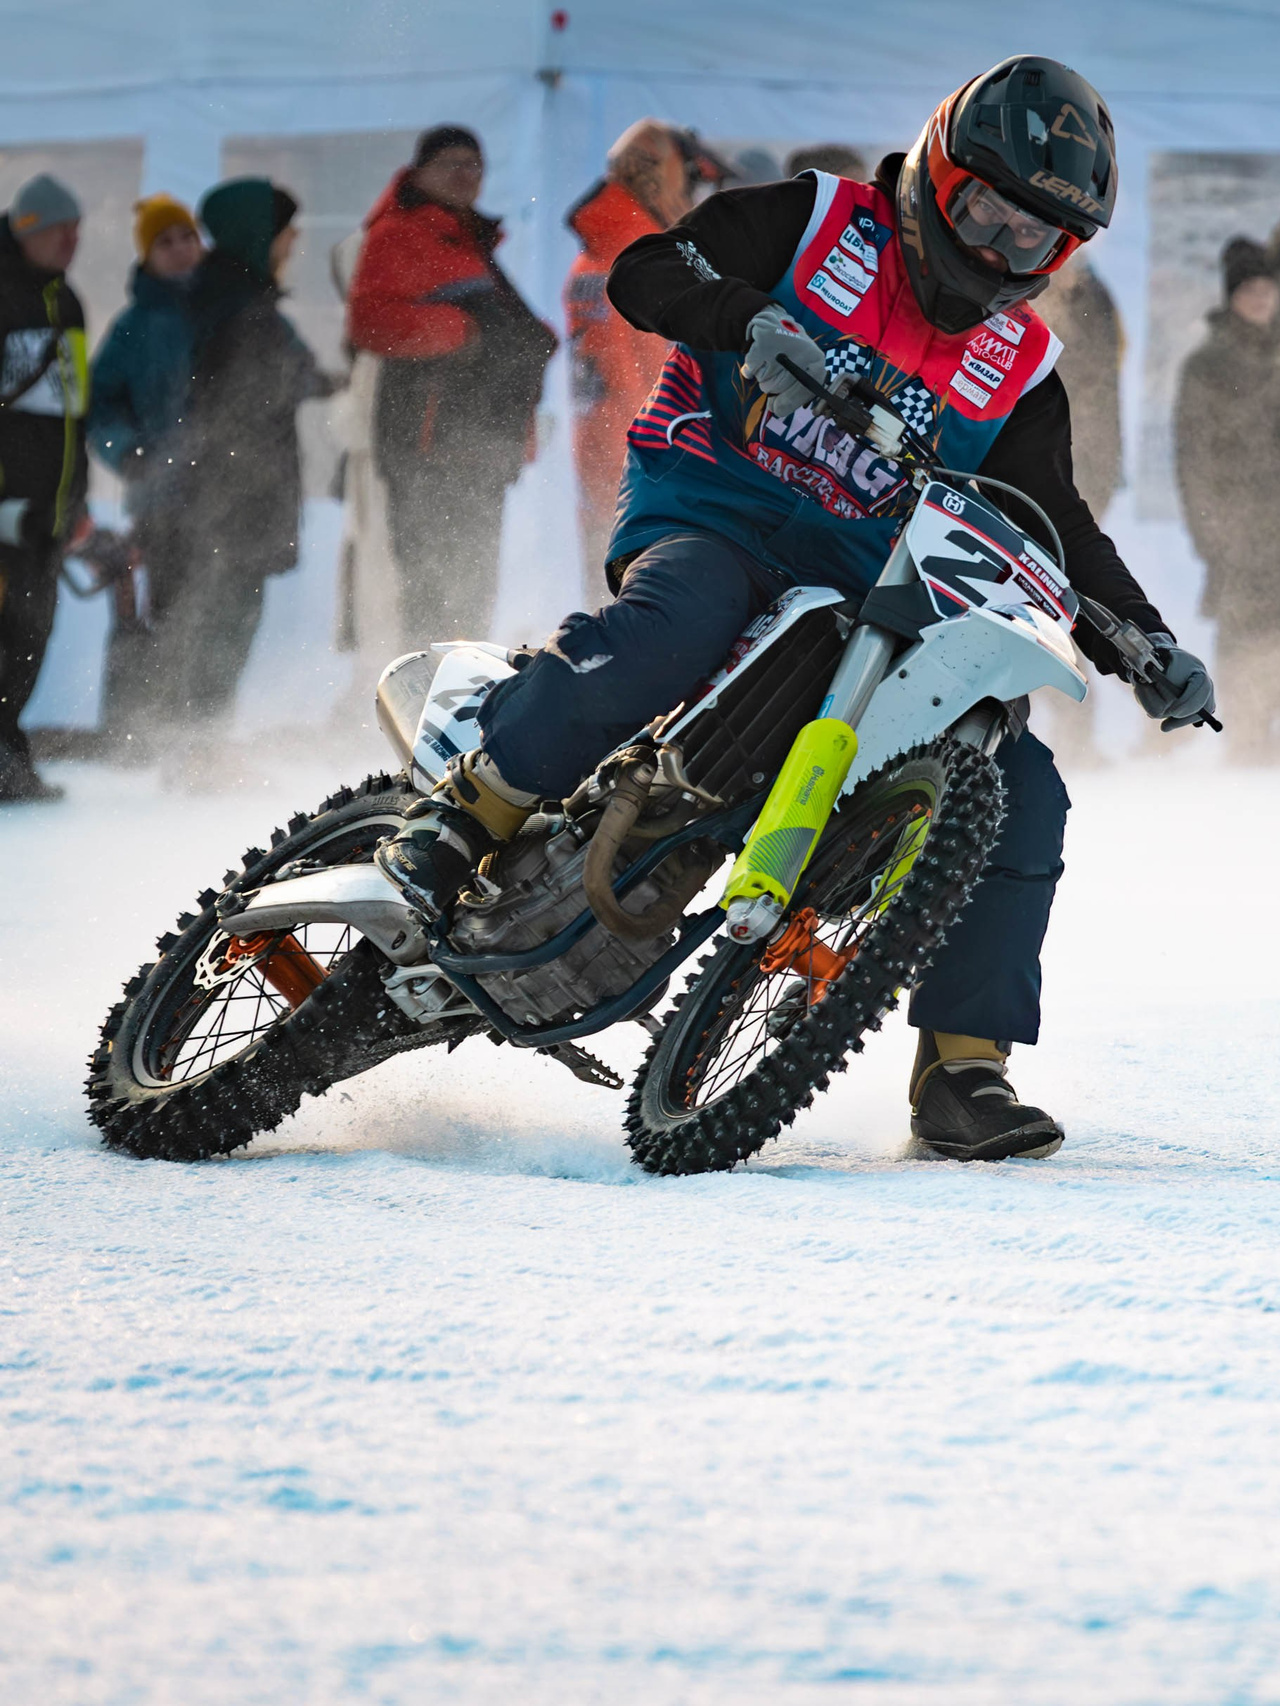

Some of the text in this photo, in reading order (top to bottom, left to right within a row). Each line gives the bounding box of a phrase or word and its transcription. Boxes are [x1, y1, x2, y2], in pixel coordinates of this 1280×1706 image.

[968, 341, 1013, 371] MOTOCLUB
[968, 362, 1001, 383] КВАЗАР
[1018, 552, 1063, 599] KALININ
